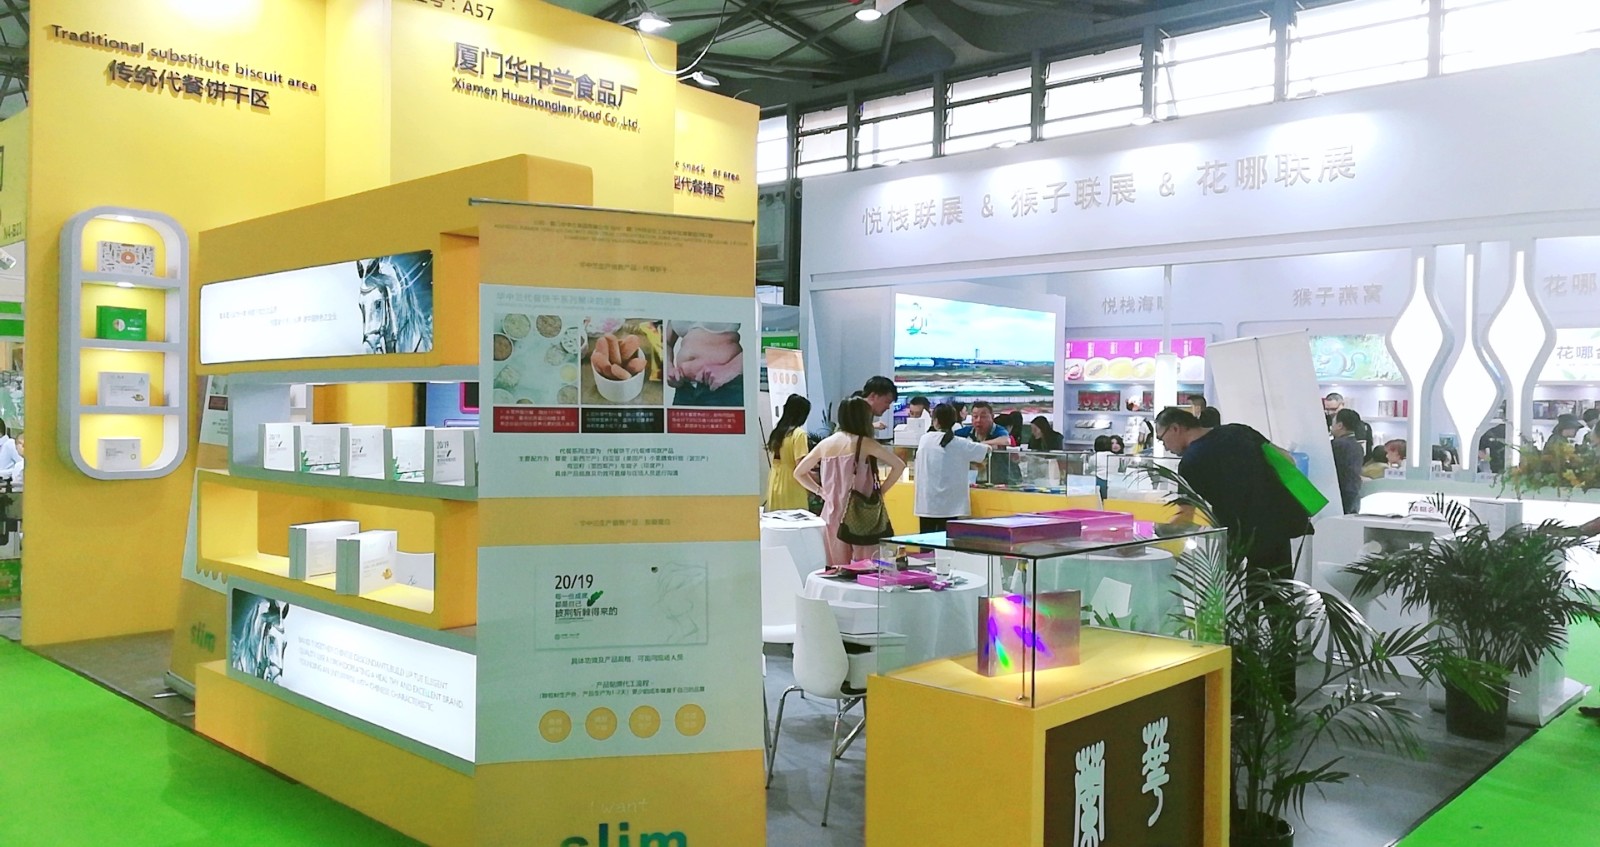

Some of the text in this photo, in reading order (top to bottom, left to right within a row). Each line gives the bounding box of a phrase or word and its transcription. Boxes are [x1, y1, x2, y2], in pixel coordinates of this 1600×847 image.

[462, 1, 494, 21] A57
[50, 24, 318, 93] Traditional substitute biscuit area
[454, 41, 638, 110] 厦门华中兰食品厂
[109, 59, 270, 110] 传统代餐饼干区
[453, 77, 498, 98] Xiamen
[577, 105, 601, 121] Food
[861, 144, 1358, 237] 悦栈联展 & 猴子联展 & 花哪联展
[1292, 283, 1384, 307] 猴子燕窝
[554, 574, 594, 590] 20/19
